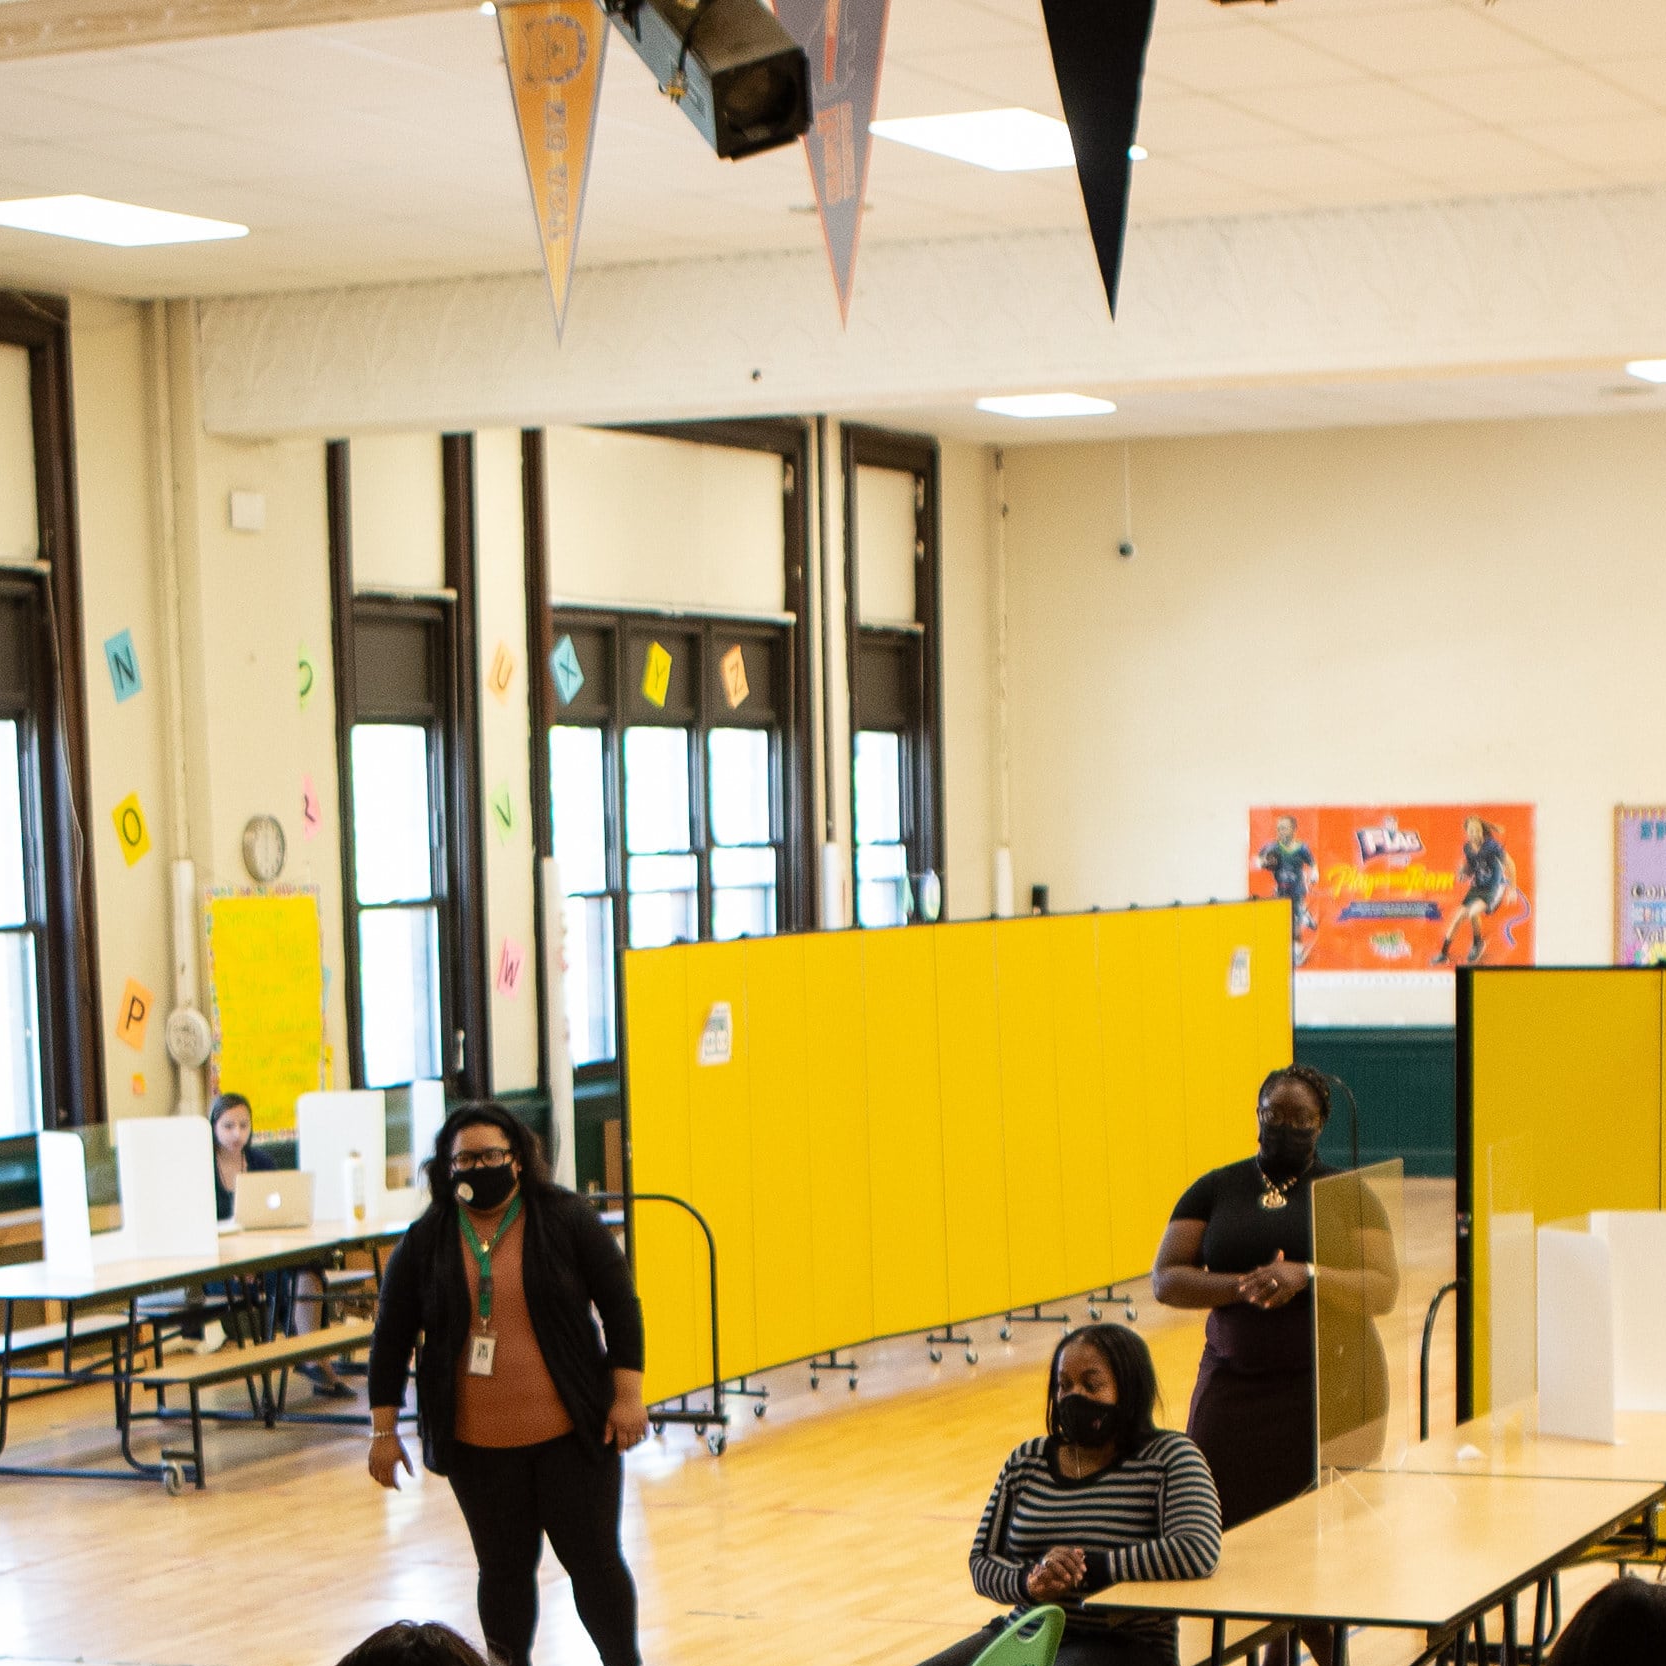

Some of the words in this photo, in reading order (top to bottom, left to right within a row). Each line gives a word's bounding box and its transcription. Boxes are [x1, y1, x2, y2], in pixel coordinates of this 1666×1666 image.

[114, 646, 136, 691] N
[560, 651, 578, 690] X
[123, 808, 142, 846] O
[496, 792, 512, 828] V
[503, 949, 521, 988] W
[126, 995, 145, 1030] P
